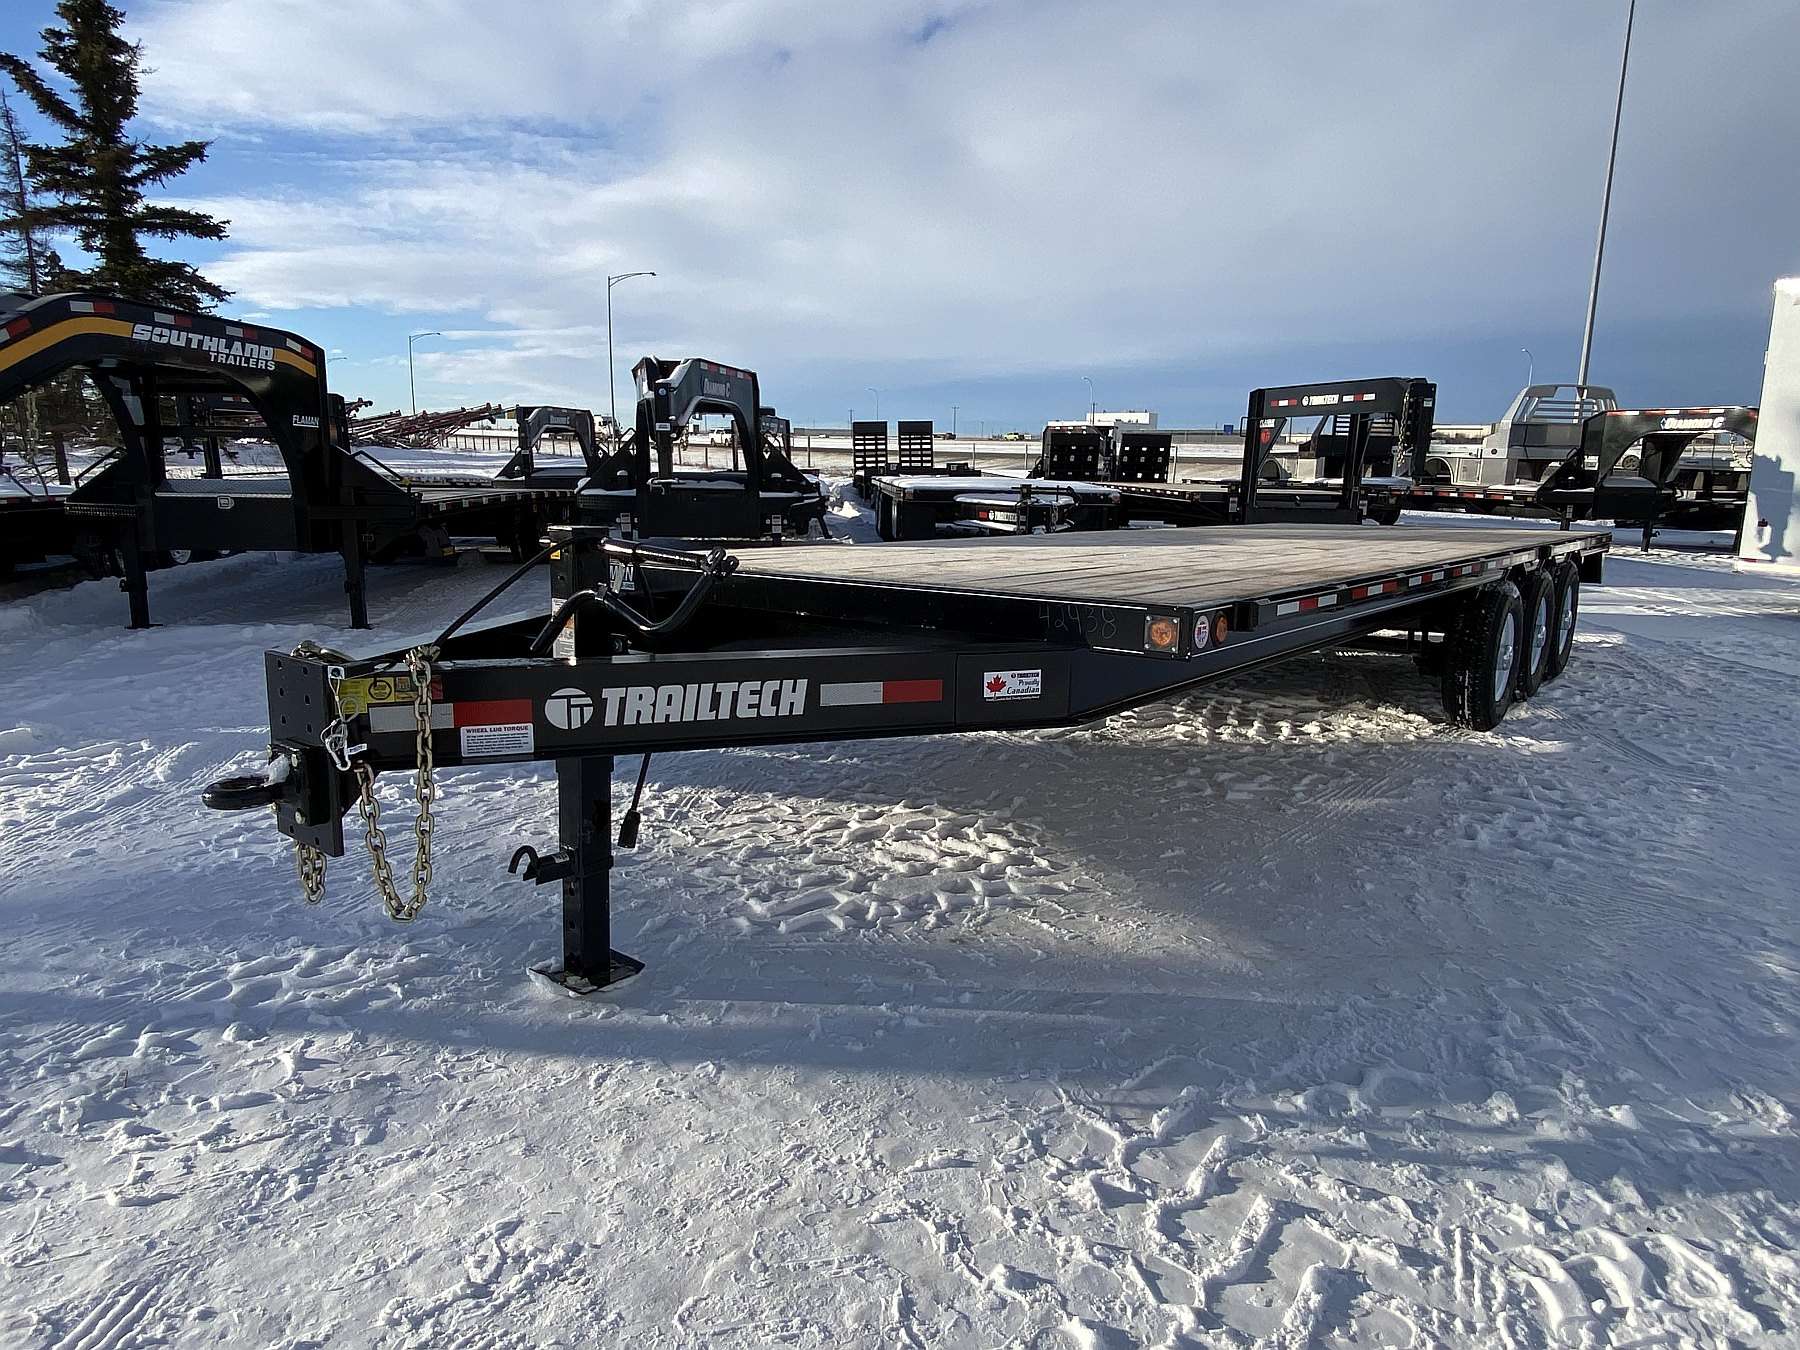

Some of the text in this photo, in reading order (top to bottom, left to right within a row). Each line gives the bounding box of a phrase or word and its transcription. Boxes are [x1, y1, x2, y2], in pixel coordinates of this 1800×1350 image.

[132, 323, 274, 361] SOUTHLAND
[209, 351, 276, 371] TRAILERS
[1664, 417, 1713, 430] DIAMOND
[1007, 686, 1040, 695] Canadian
[1018, 679, 1040, 687] Proudly
[601, 678, 808, 727] TRAILTECH
